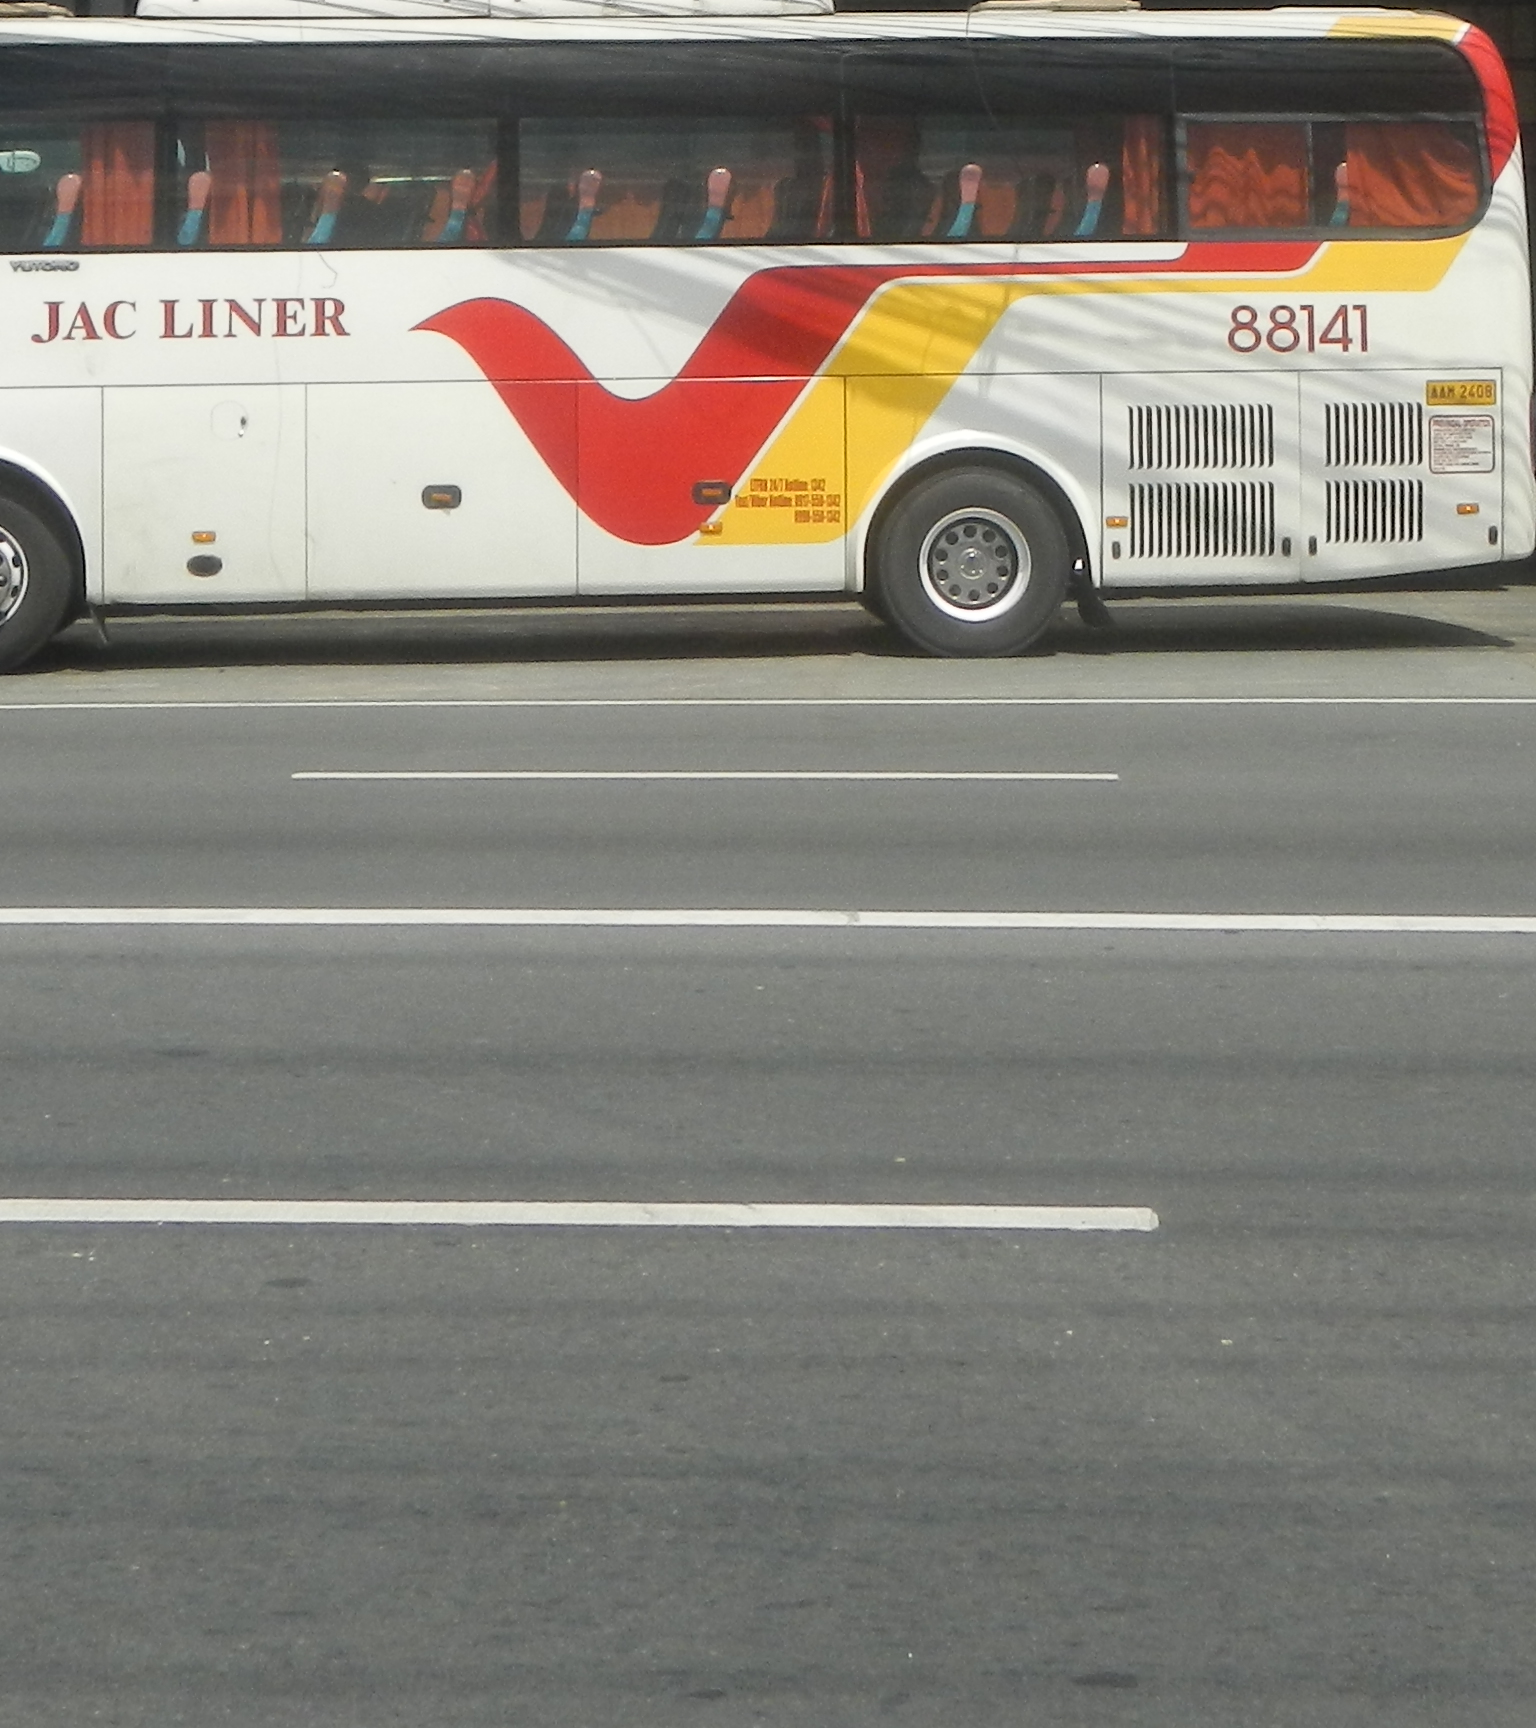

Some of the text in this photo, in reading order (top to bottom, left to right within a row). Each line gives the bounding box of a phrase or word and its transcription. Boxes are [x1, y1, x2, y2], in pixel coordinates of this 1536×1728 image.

[30, 297, 351, 344] JAC LINER
[1227, 304, 1368, 353] 88141
